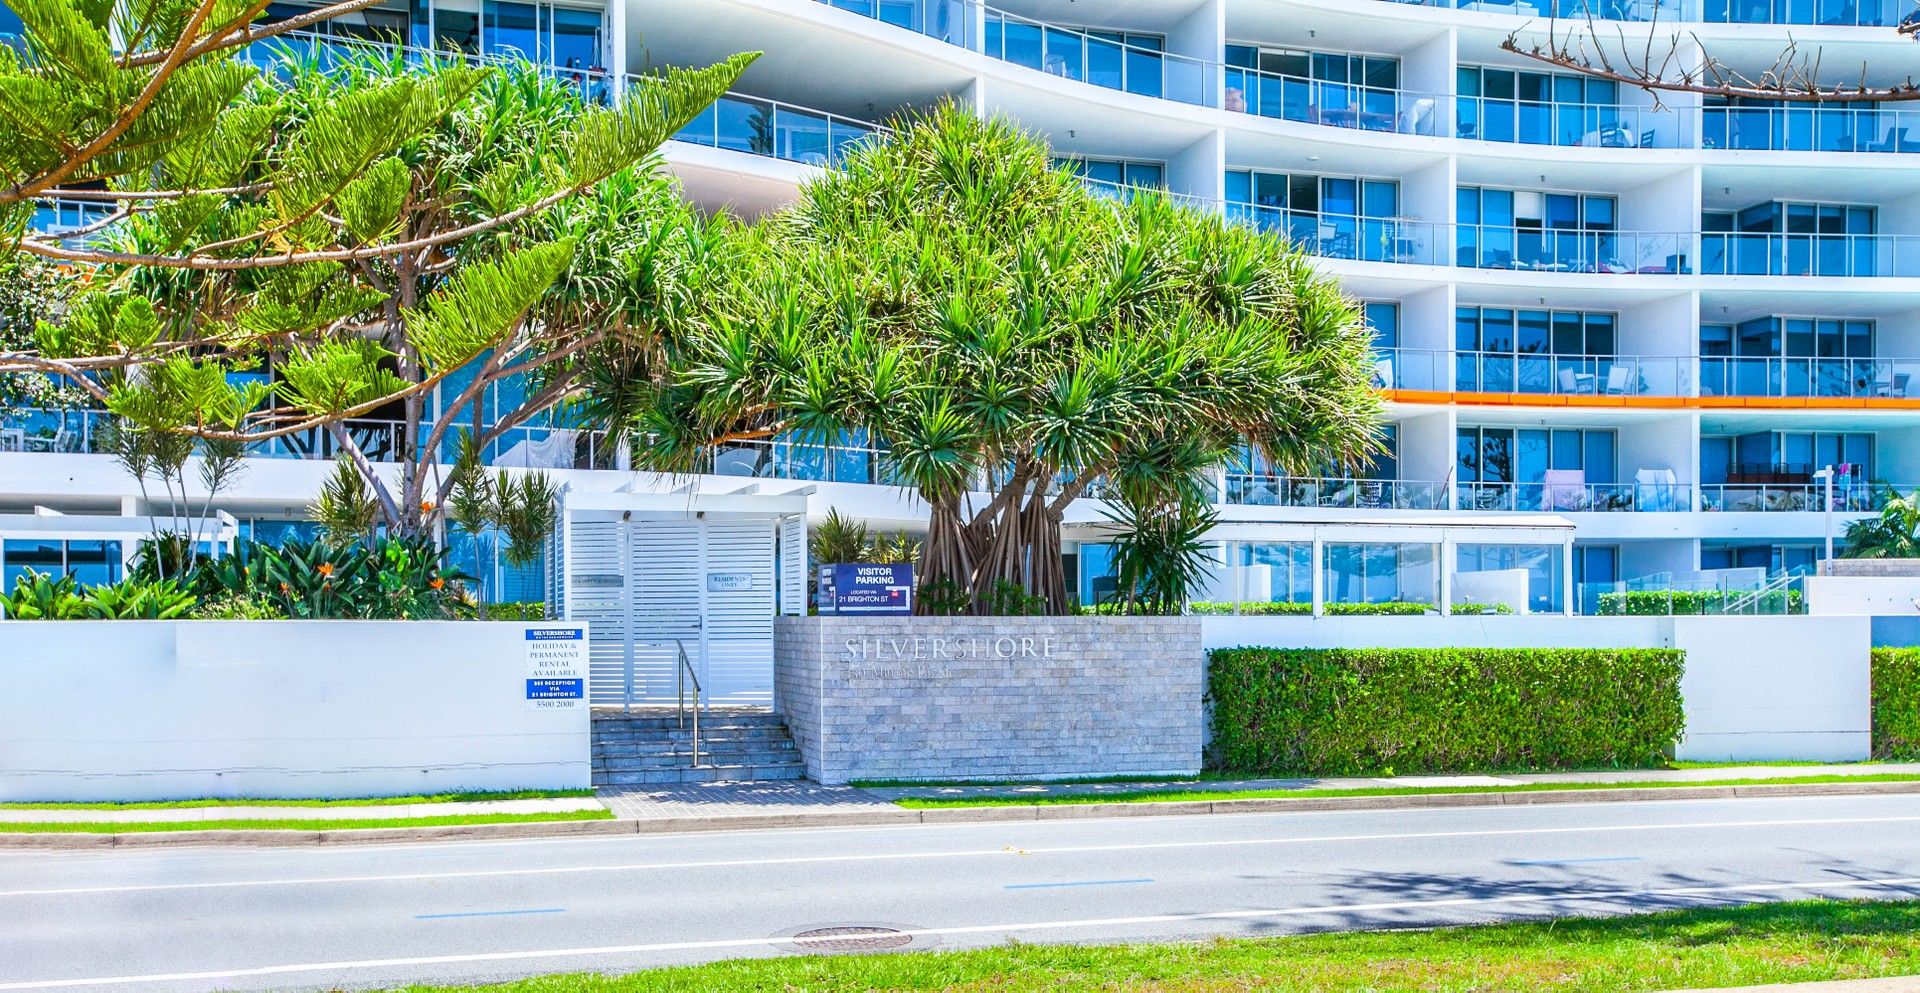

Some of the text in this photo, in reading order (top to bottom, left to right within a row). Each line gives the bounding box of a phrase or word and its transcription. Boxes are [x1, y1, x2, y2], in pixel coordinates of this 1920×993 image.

[857, 567, 892, 576] VISITOR
[855, 576, 895, 585] PARKING
[847, 595, 879, 603] BRIGHTON
[880, 595, 889, 603] ST
[844, 637, 1056, 659] SILVERSHORE
[536, 700, 575, 708] 5500 2000
